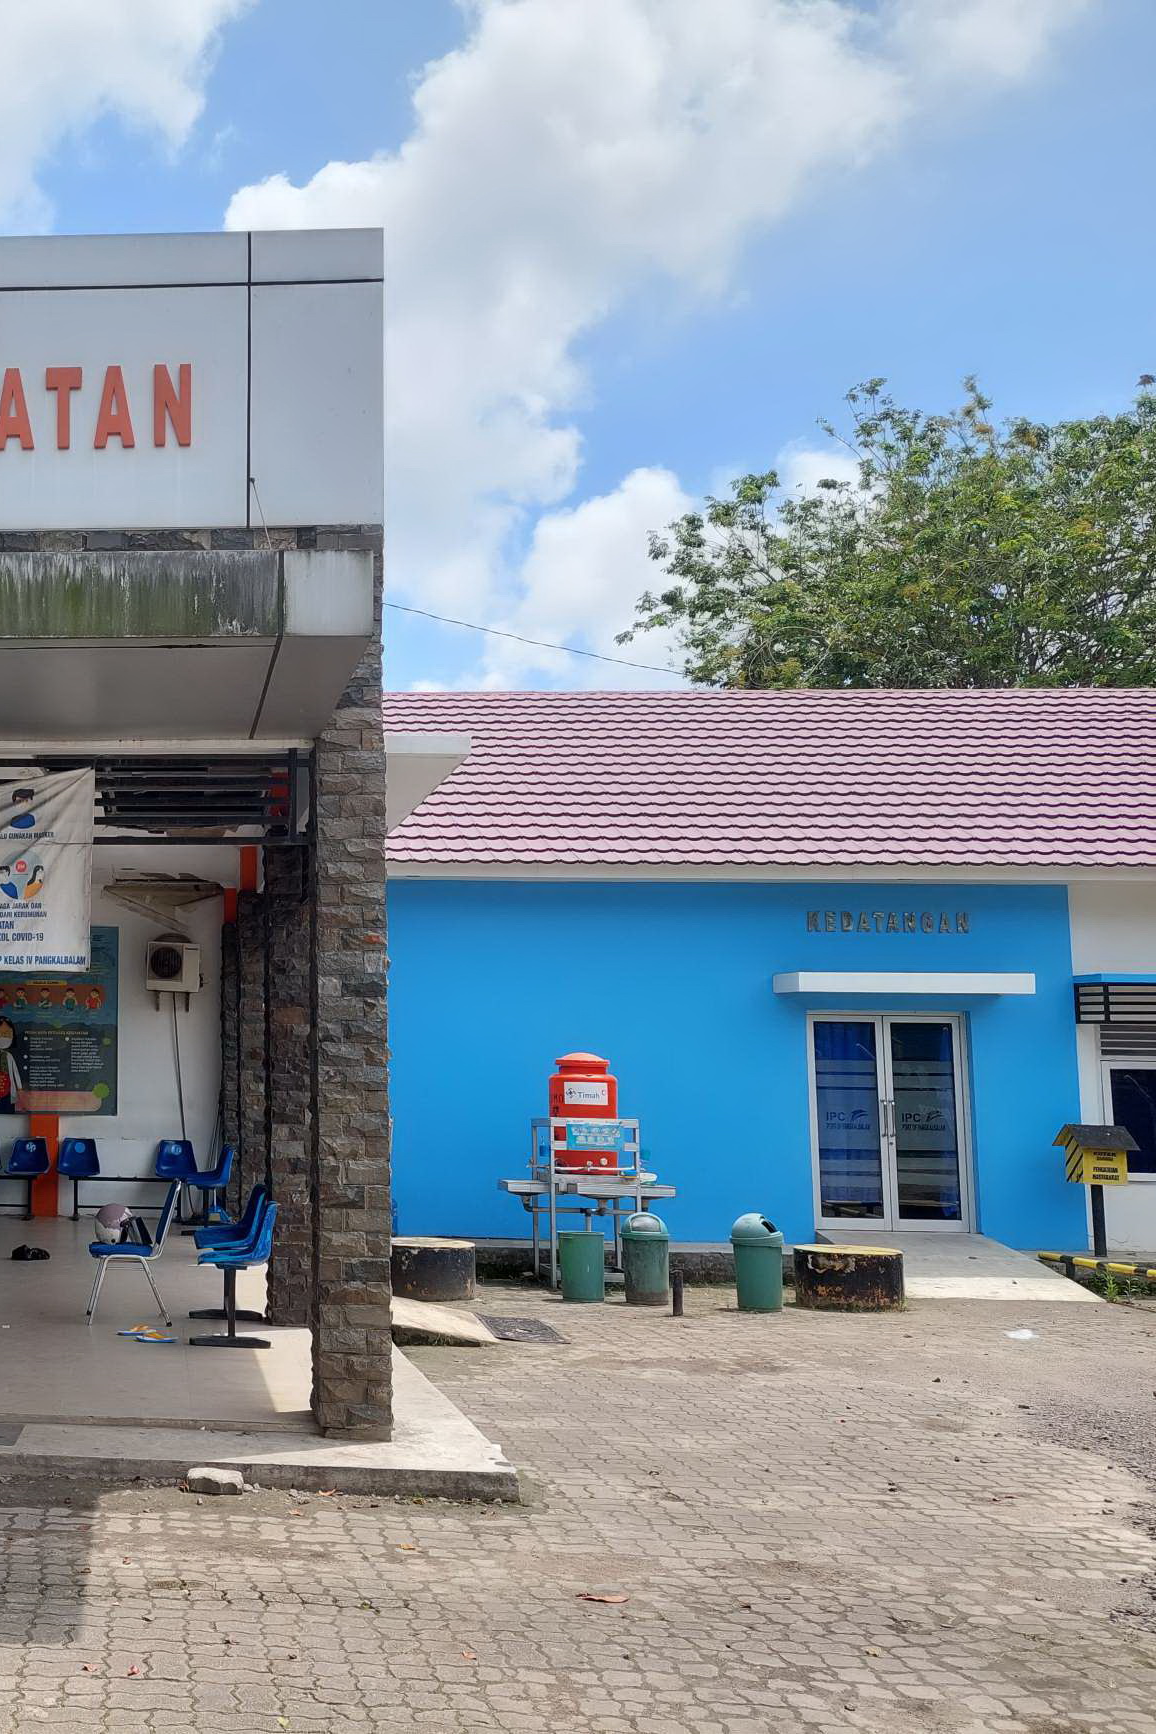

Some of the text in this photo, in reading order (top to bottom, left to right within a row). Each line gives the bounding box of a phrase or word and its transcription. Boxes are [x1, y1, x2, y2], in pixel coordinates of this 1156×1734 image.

[807, 911, 970, 933] KEDATANGAN
[11, 932, 44, 942] COVID-19
[3, 956, 24, 965] KELAS
[26, 956, 32, 964] IV
[34, 955, 86, 965] PANGKALBALAM
[577, 1091, 600, 1099] Timah
[826, 1111, 846, 1121] IPC
[901, 1113, 921, 1122] IPC
